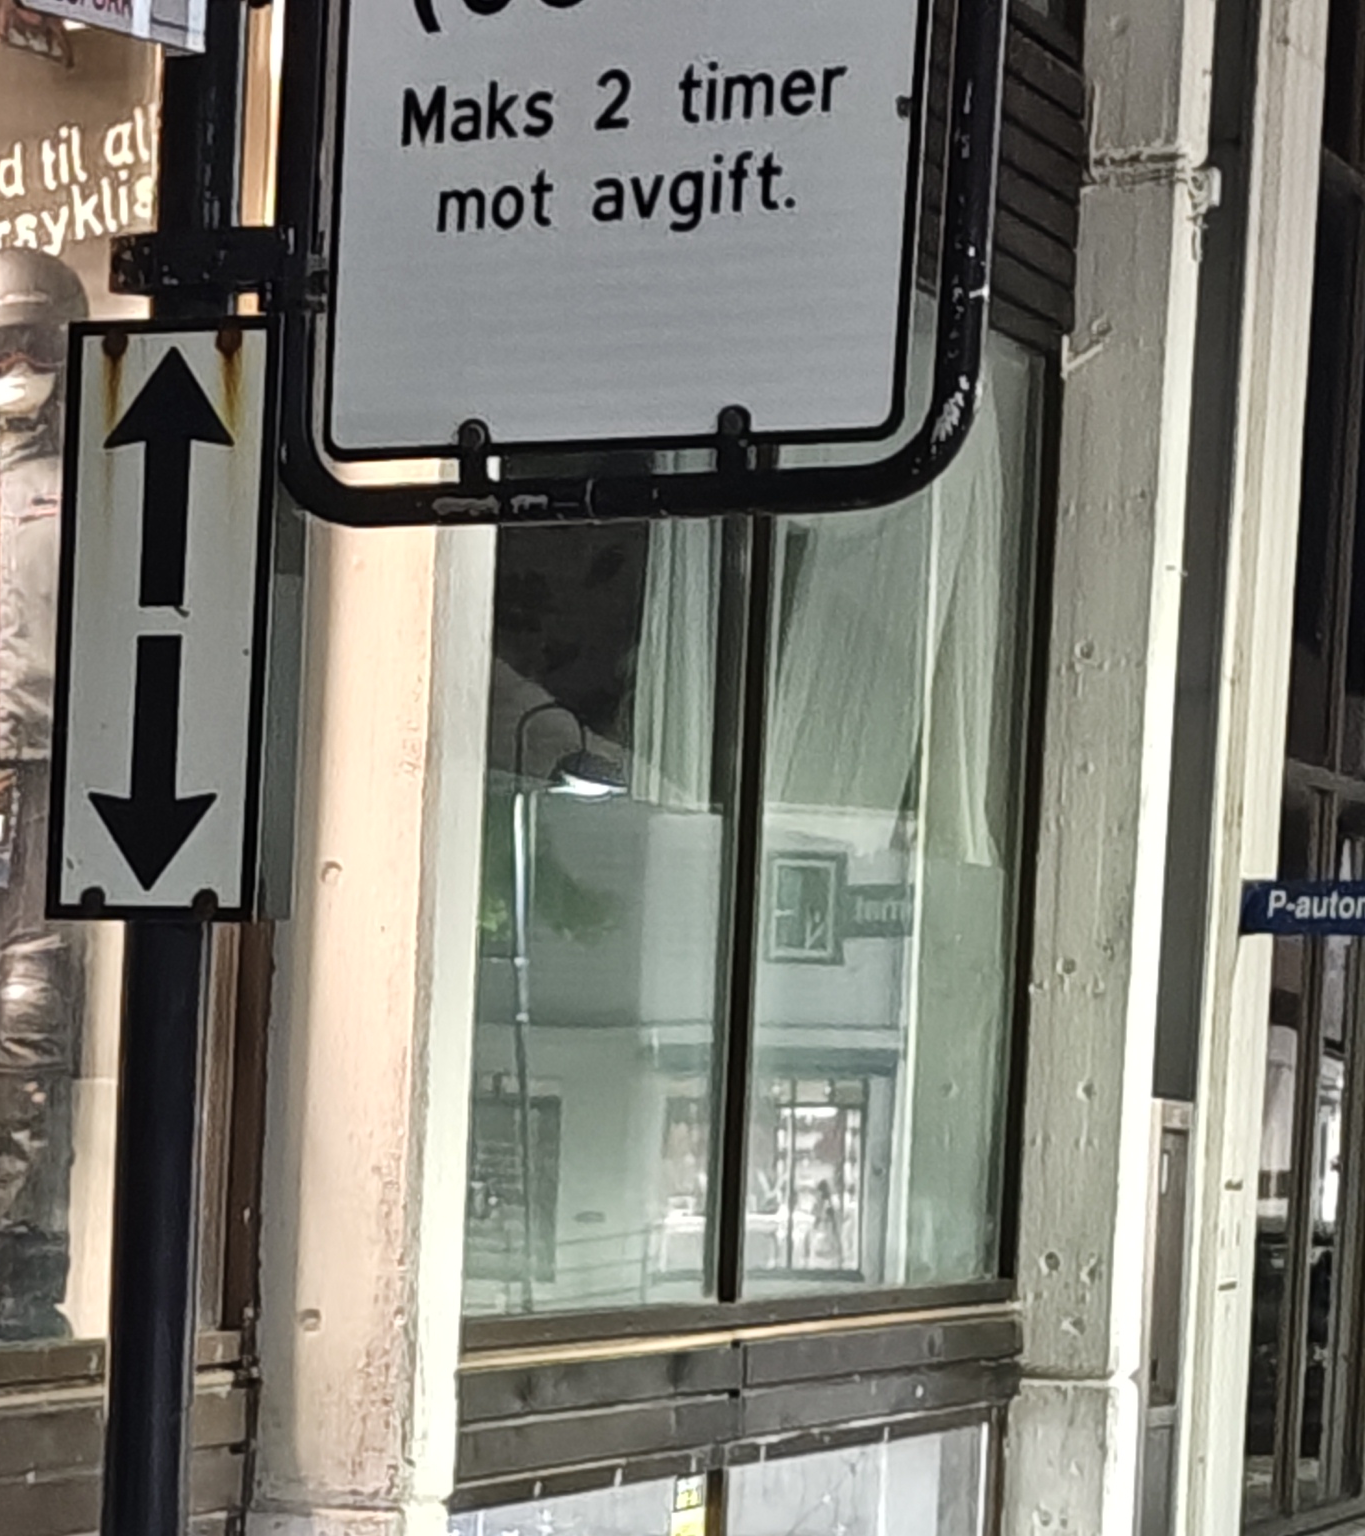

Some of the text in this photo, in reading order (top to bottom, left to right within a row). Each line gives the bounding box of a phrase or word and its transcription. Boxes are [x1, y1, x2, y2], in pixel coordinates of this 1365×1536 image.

[401, 60, 848, 147] Maks 2 timer
[41, 124, 87, 190] til
[436, 150, 797, 233] mot avgift.
